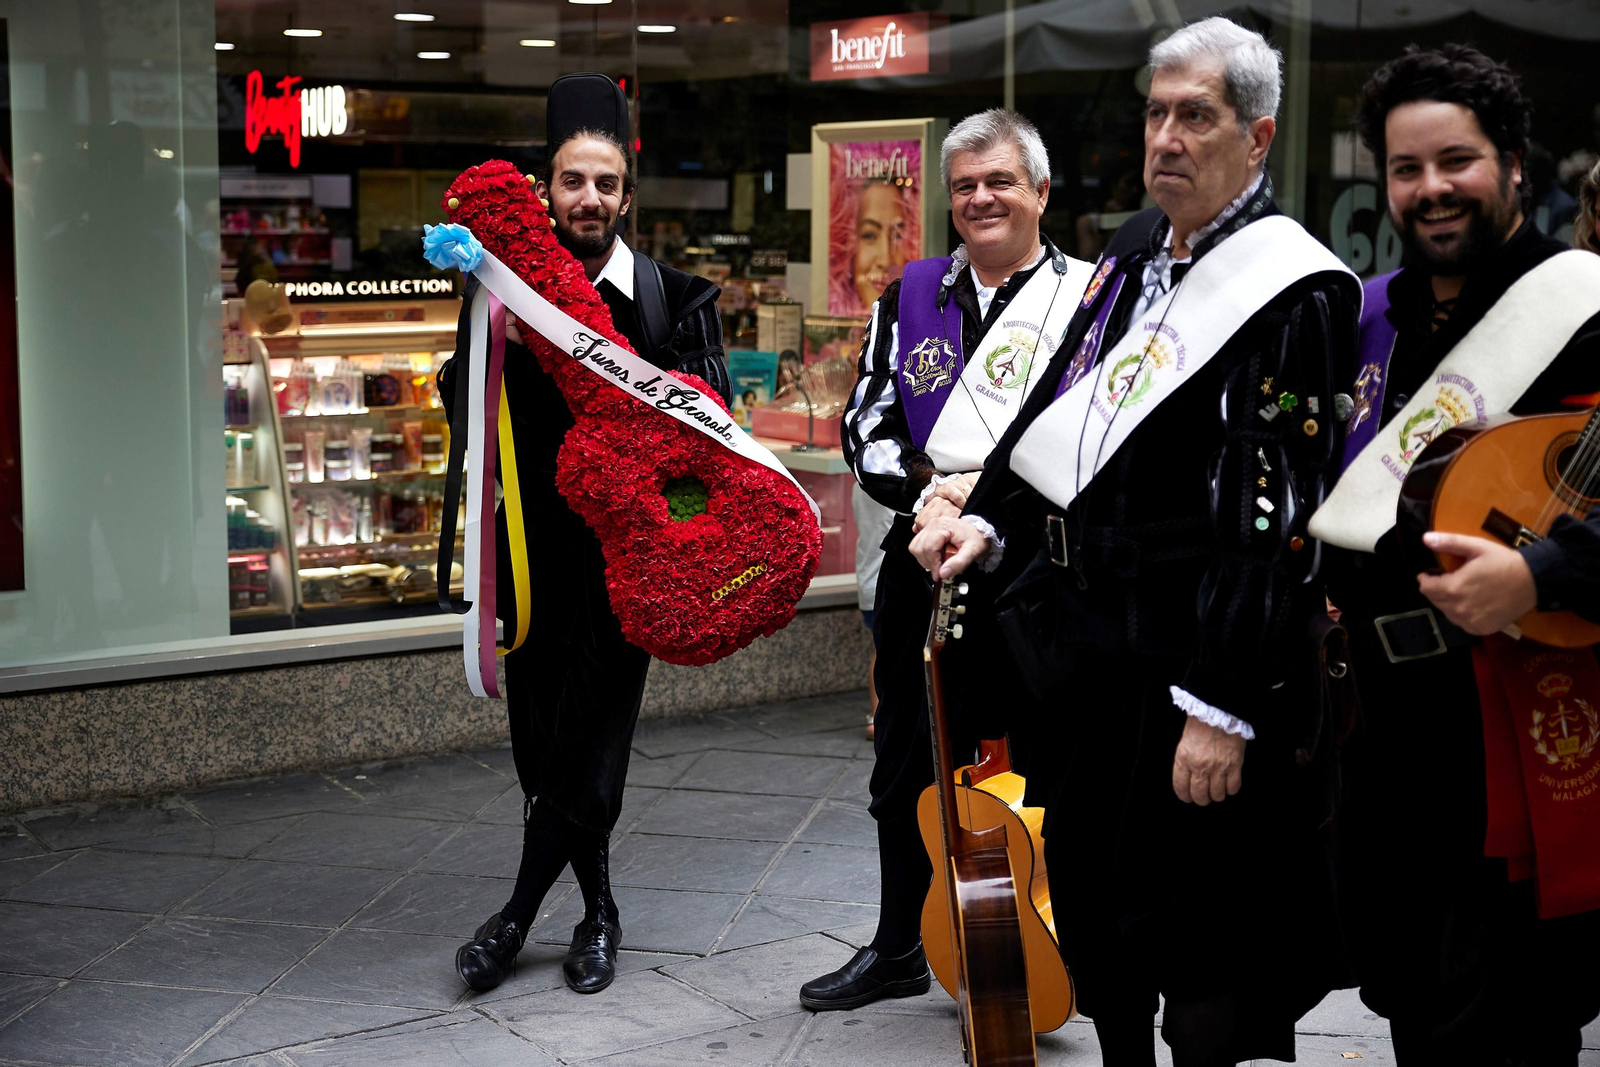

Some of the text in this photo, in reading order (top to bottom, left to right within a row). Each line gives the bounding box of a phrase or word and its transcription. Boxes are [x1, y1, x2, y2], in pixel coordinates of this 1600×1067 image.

[830, 22, 906, 69] benefit
[301, 85, 347, 137] HUB
[845, 147, 910, 185] benefit
[268, 279, 453, 297] PHORA COLLECTION
[1002, 320, 1041, 335] ARQUITECTURA
[1143, 322, 1180, 345] ARQUITECTURA
[915, 347, 940, 377] 50
[572, 332, 737, 447] Tunas de Granada
[975, 384, 1008, 406] GRANADA
[1435, 373, 1478, 396] ARQUITECTURA
[1091, 395, 1113, 425] GRANAD
[1381, 454, 1407, 482] GRANAD
[1523, 652, 1575, 673] DERECHO
[1552, 782, 1599, 801] MALAGA
